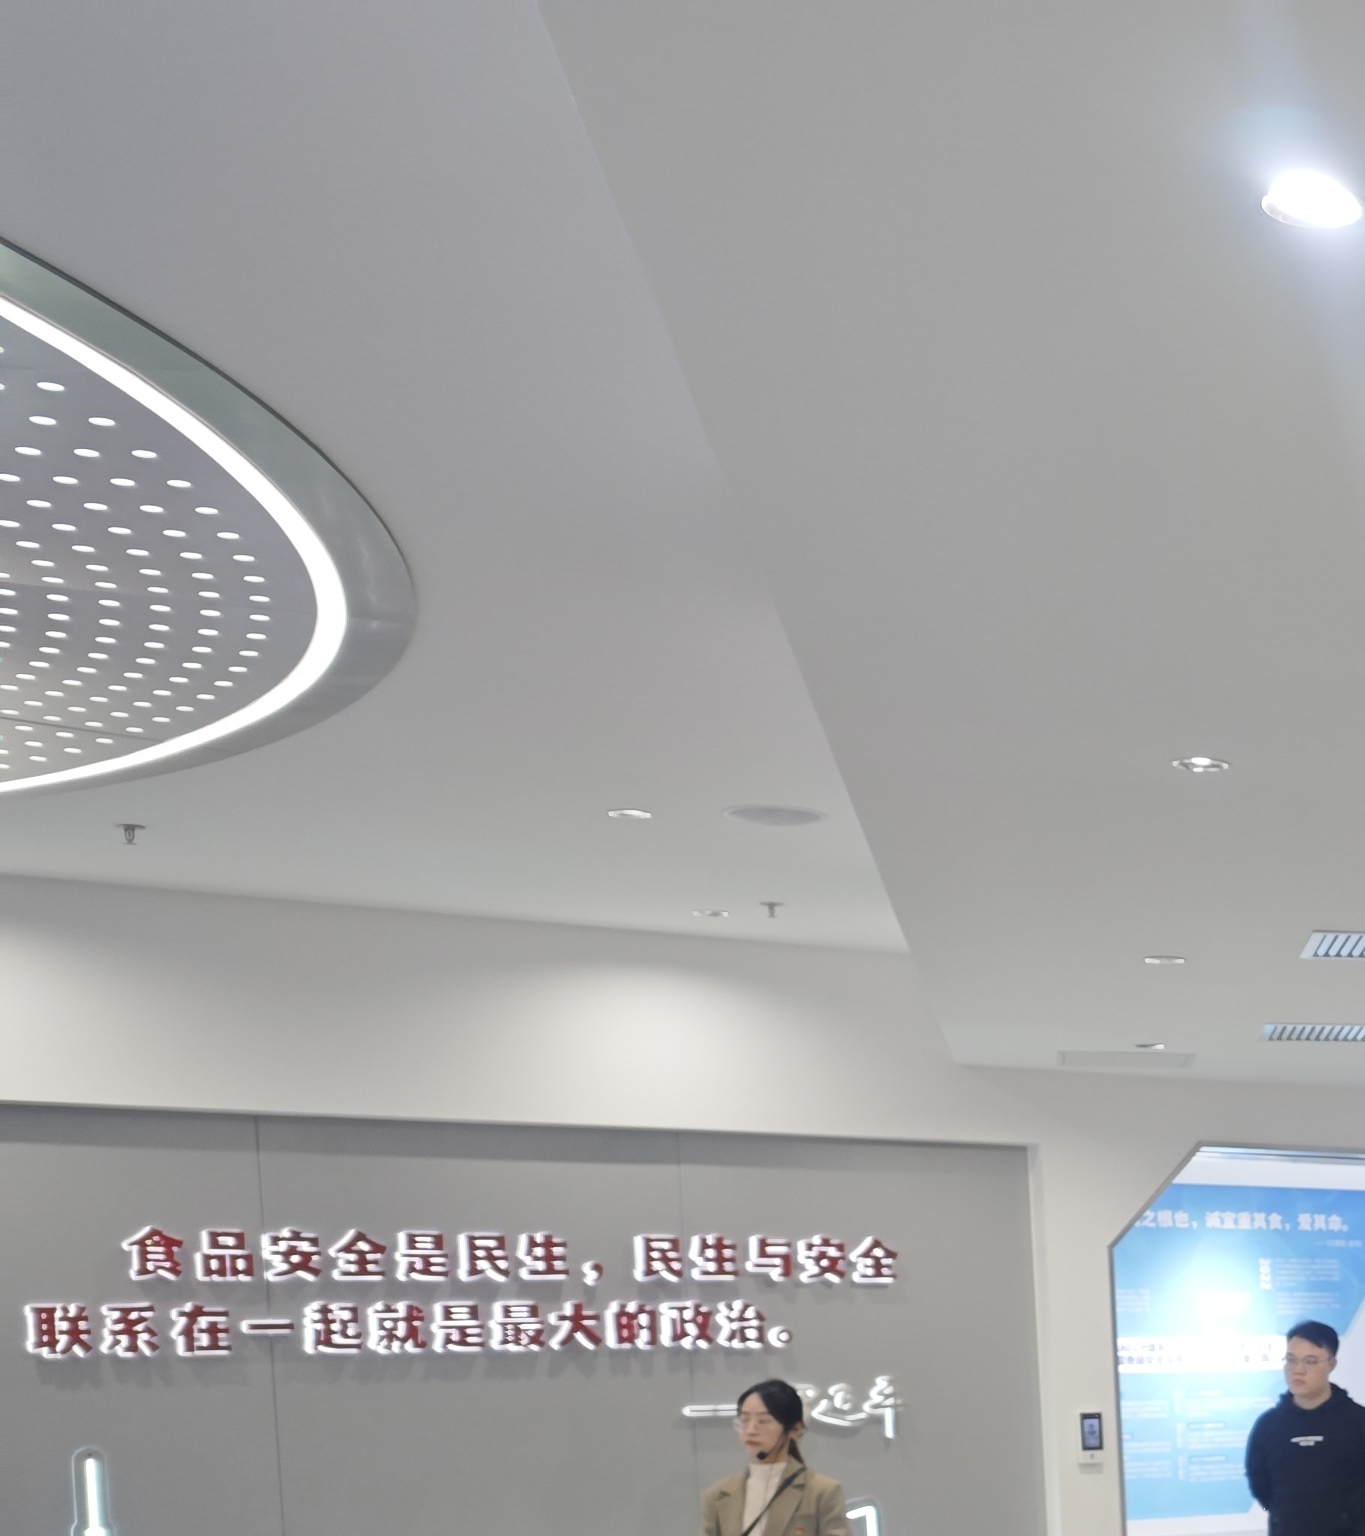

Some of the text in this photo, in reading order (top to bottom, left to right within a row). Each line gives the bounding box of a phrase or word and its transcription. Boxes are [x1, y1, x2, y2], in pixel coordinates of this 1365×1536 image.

[122, 1225, 898, 1286] 食品安全是民生，民生与安全
[24, 1299, 793, 1358] 联系在一起就是最大的政治。
